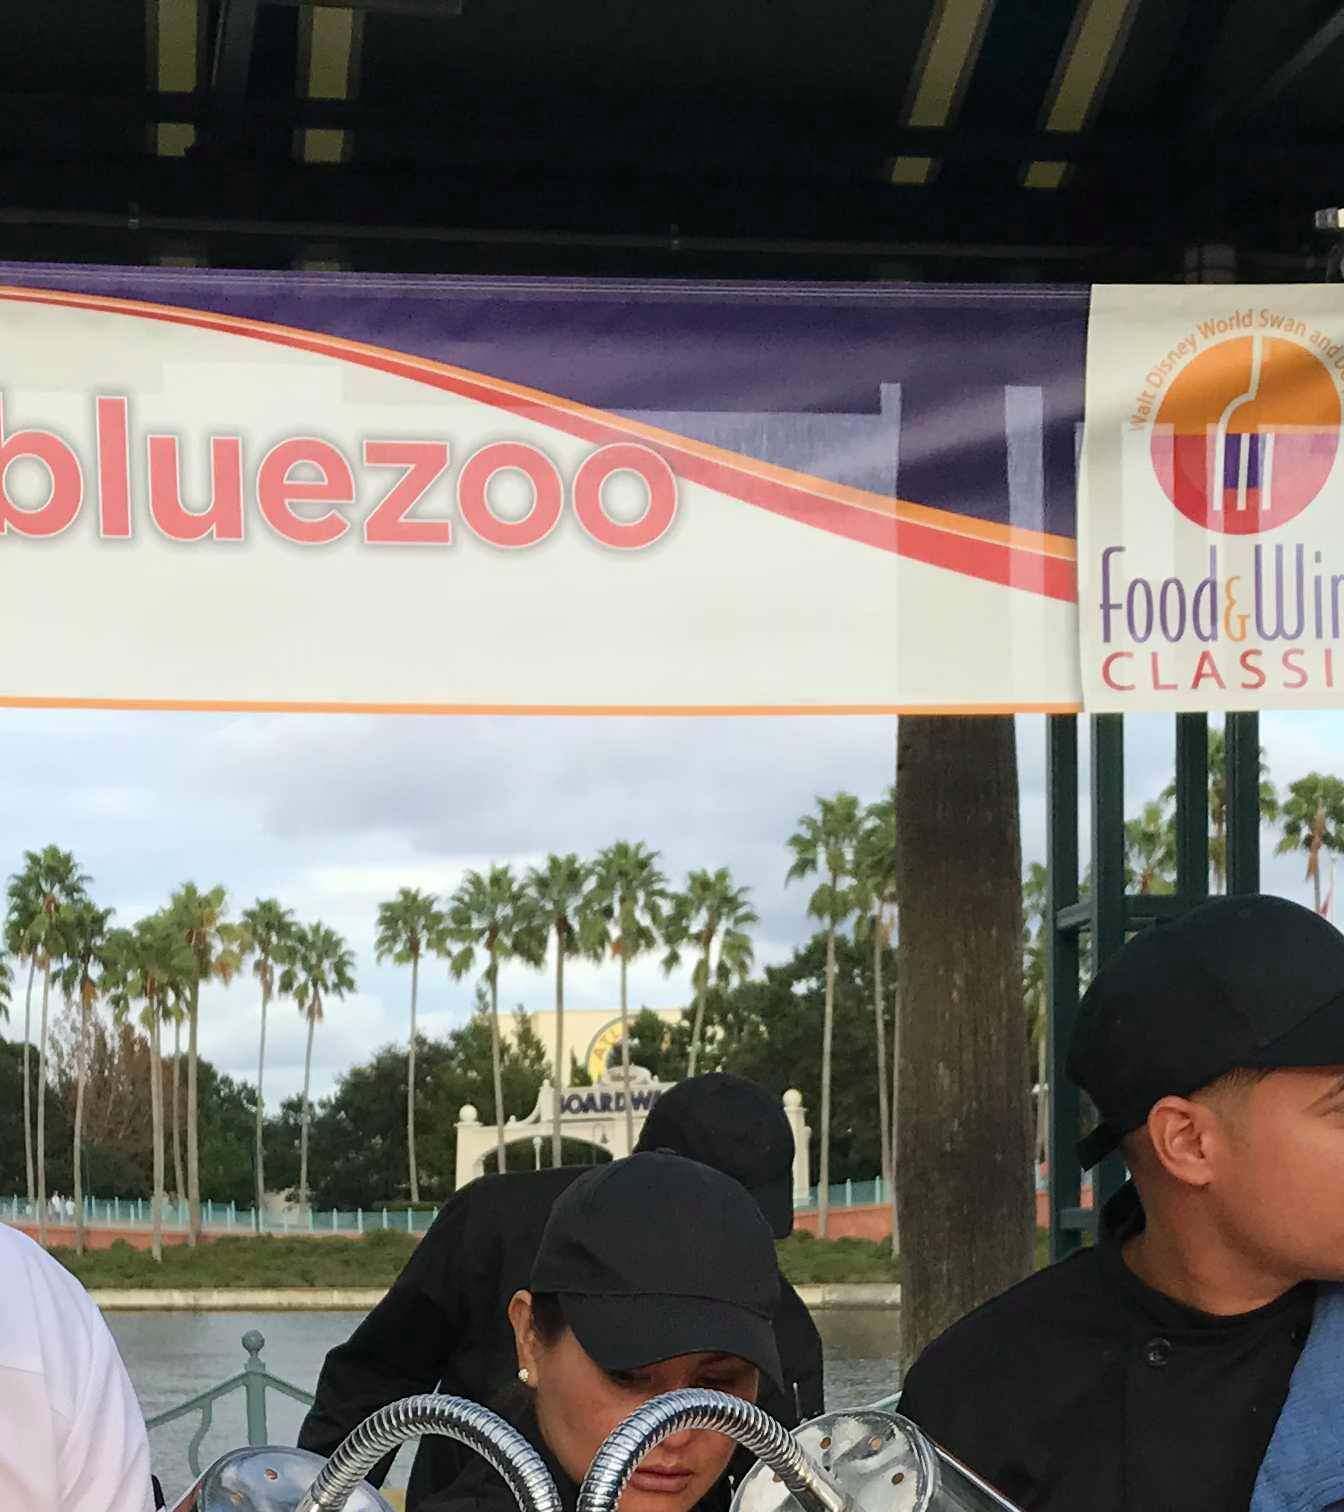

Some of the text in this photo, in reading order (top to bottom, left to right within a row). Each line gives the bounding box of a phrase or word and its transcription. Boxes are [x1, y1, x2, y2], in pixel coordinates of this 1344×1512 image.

[1128, 390, 1156, 432] Walt
[1146, 334, 1197, 389] Disney
[1197, 309, 1253, 339] World
[1257, 308, 1307, 336] Swan
[1309, 330, 1343, 359] and
